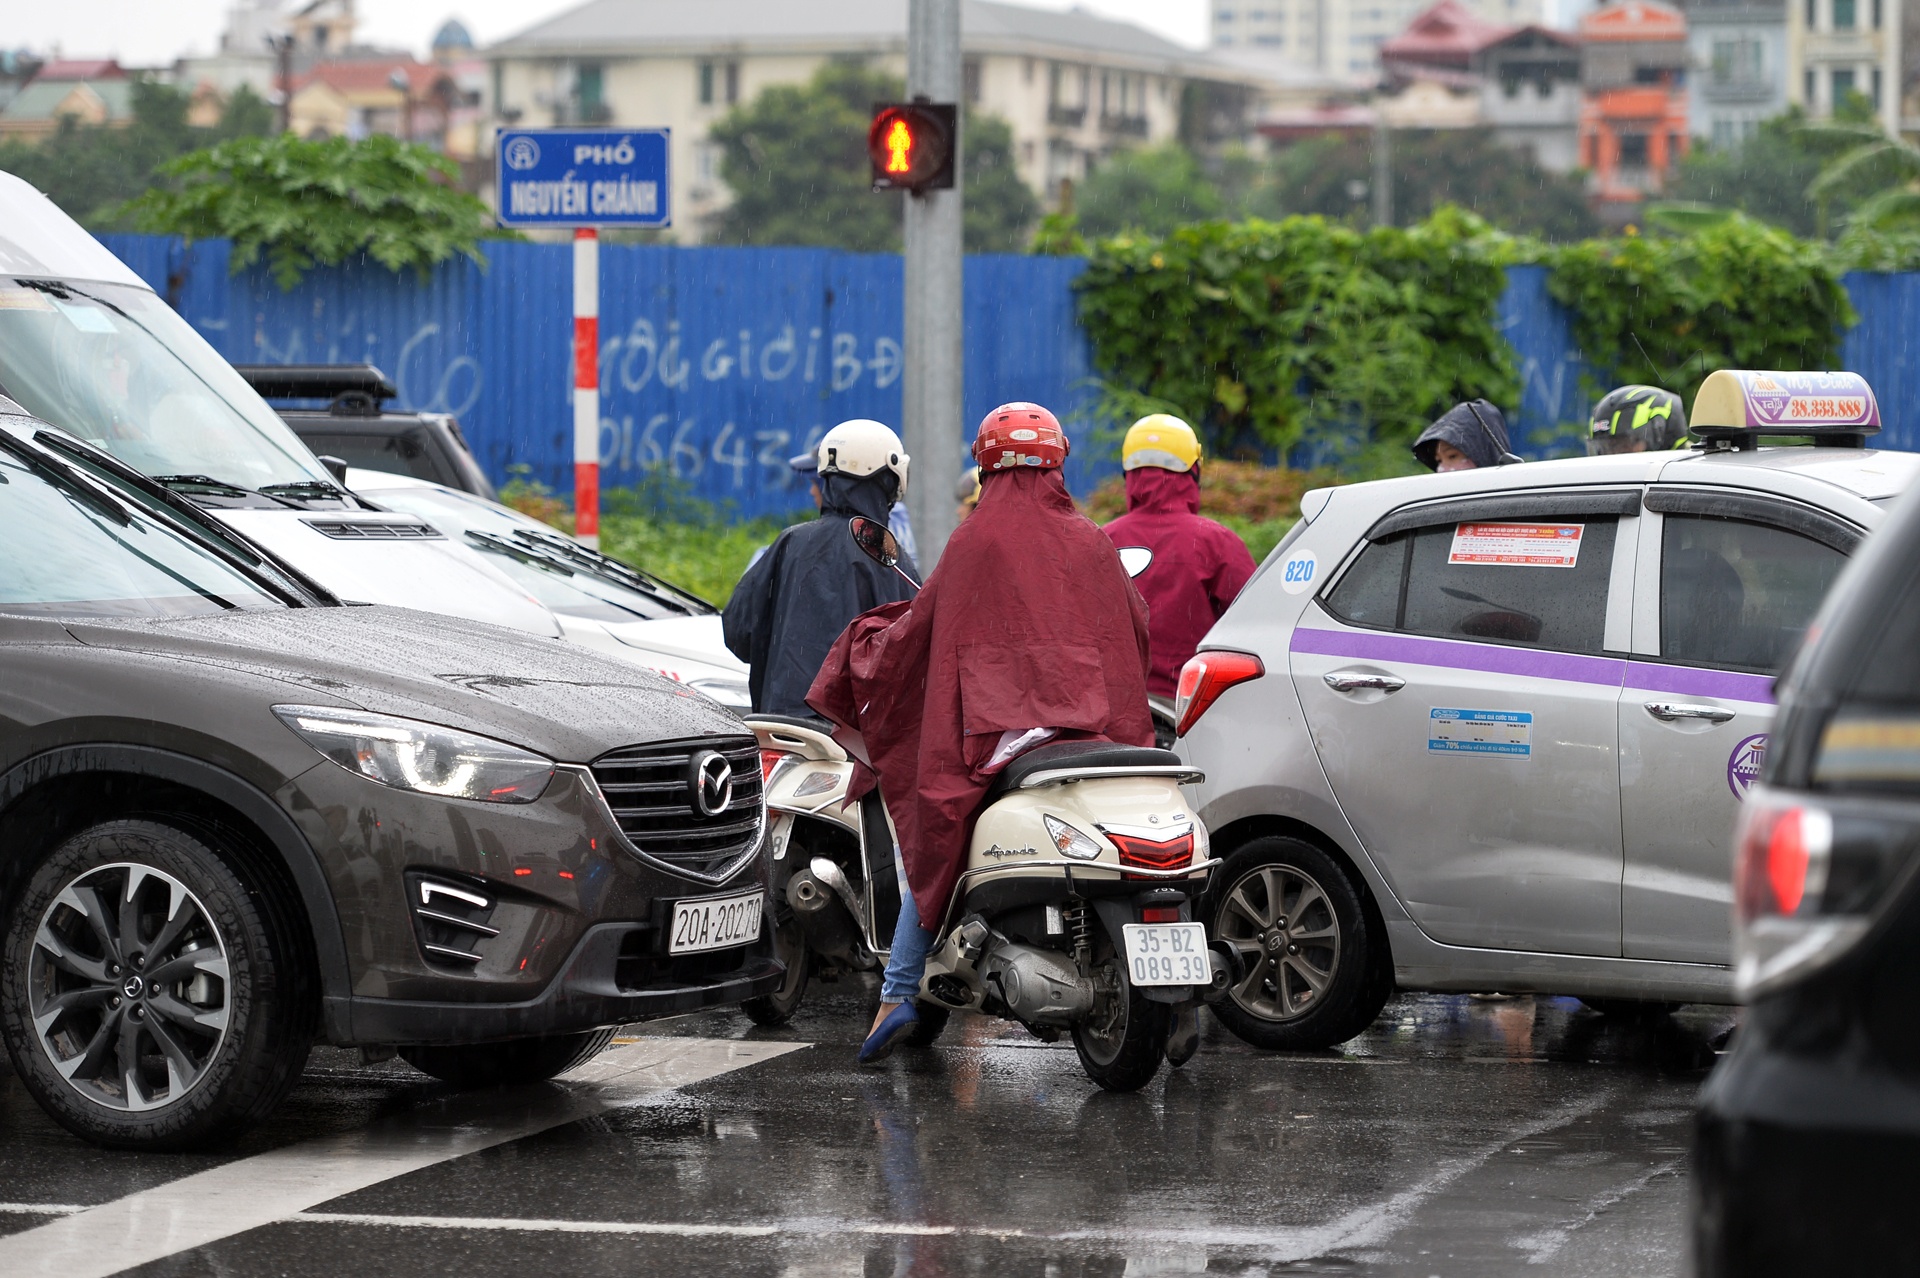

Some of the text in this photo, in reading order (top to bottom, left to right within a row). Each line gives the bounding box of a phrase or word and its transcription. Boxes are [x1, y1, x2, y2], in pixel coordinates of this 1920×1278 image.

[574, 135, 636, 165] PHỐ
[591, 173, 658, 215] CHÁNH
[1791, 400, 1861, 418] 38.333.888
[1285, 559, 1315, 582] 820
[1445, 741, 1459, 750] 70%
[1137, 928, 1195, 953] 35-B2
[1134, 956, 1205, 981] 089.39
